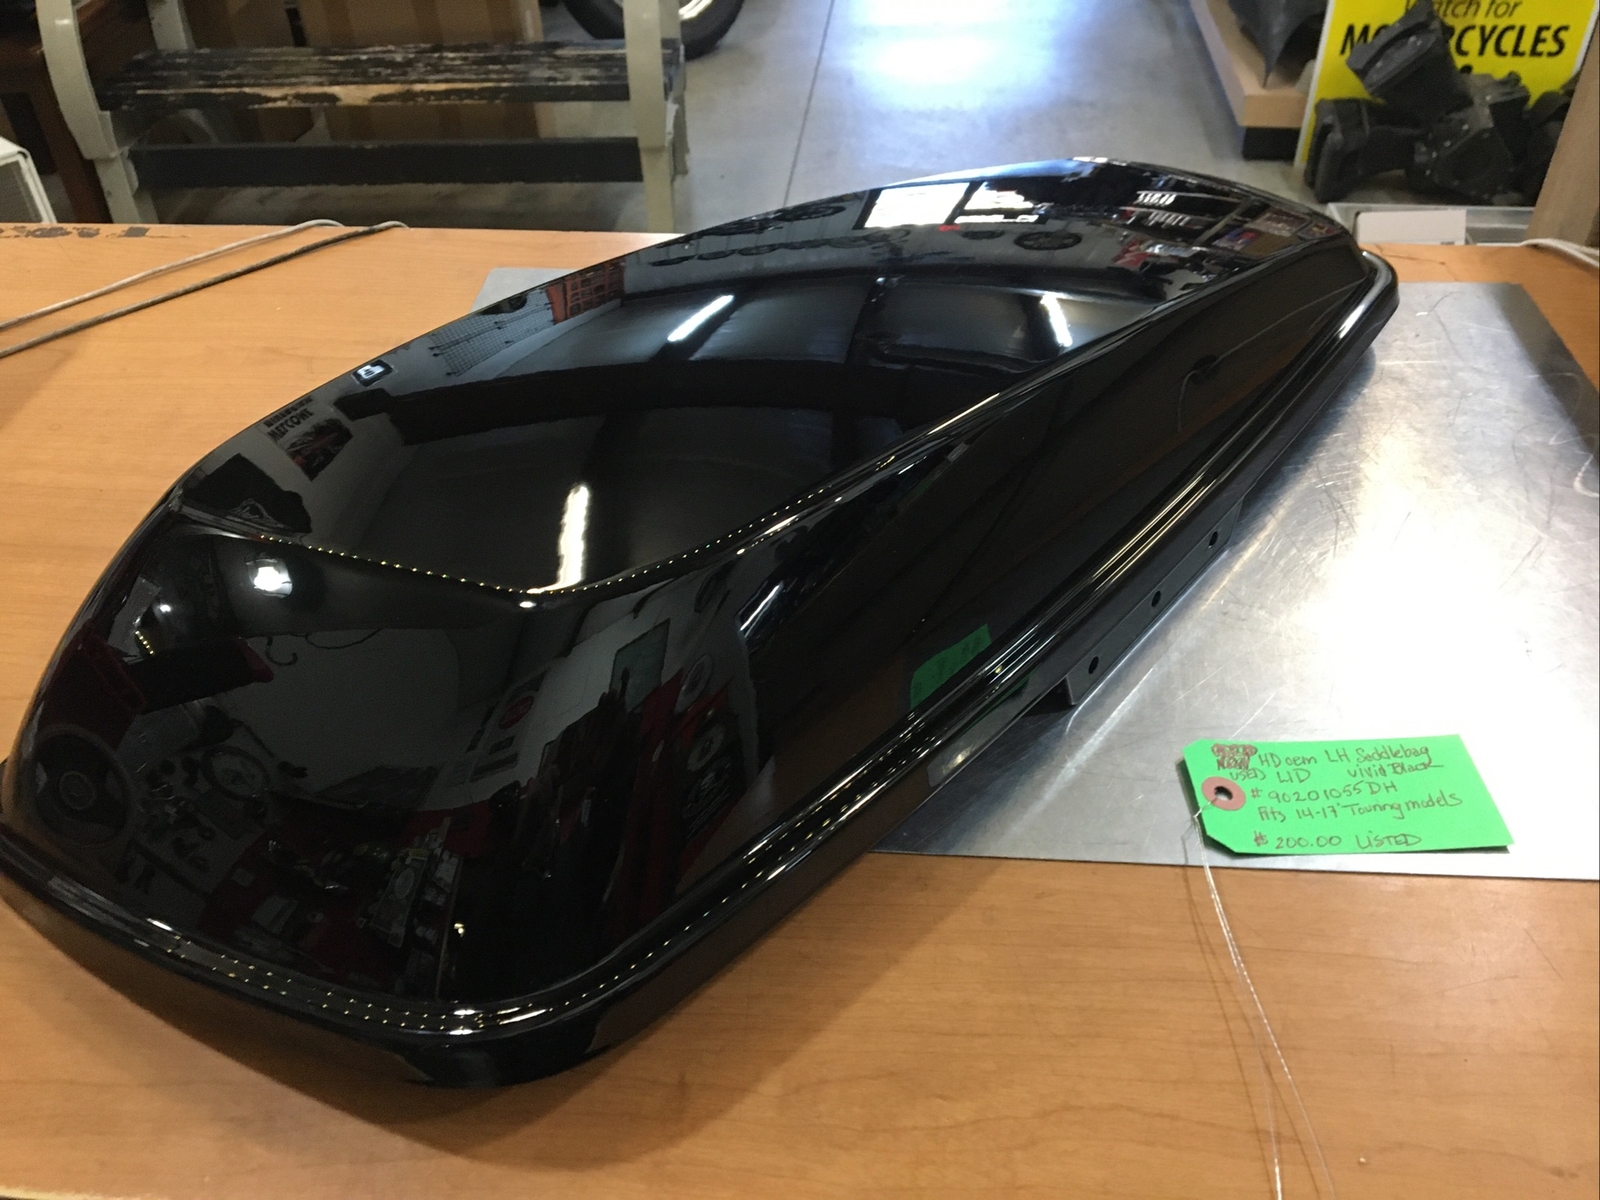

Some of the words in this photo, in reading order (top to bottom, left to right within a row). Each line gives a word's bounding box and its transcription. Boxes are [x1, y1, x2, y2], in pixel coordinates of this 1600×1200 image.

[1258, 752, 1282, 768] HD
[1324, 748, 1351, 763] LH
[1229, 767, 1267, 782] USED
[1276, 768, 1311, 783] LID
[1404, 789, 1463, 811] models
